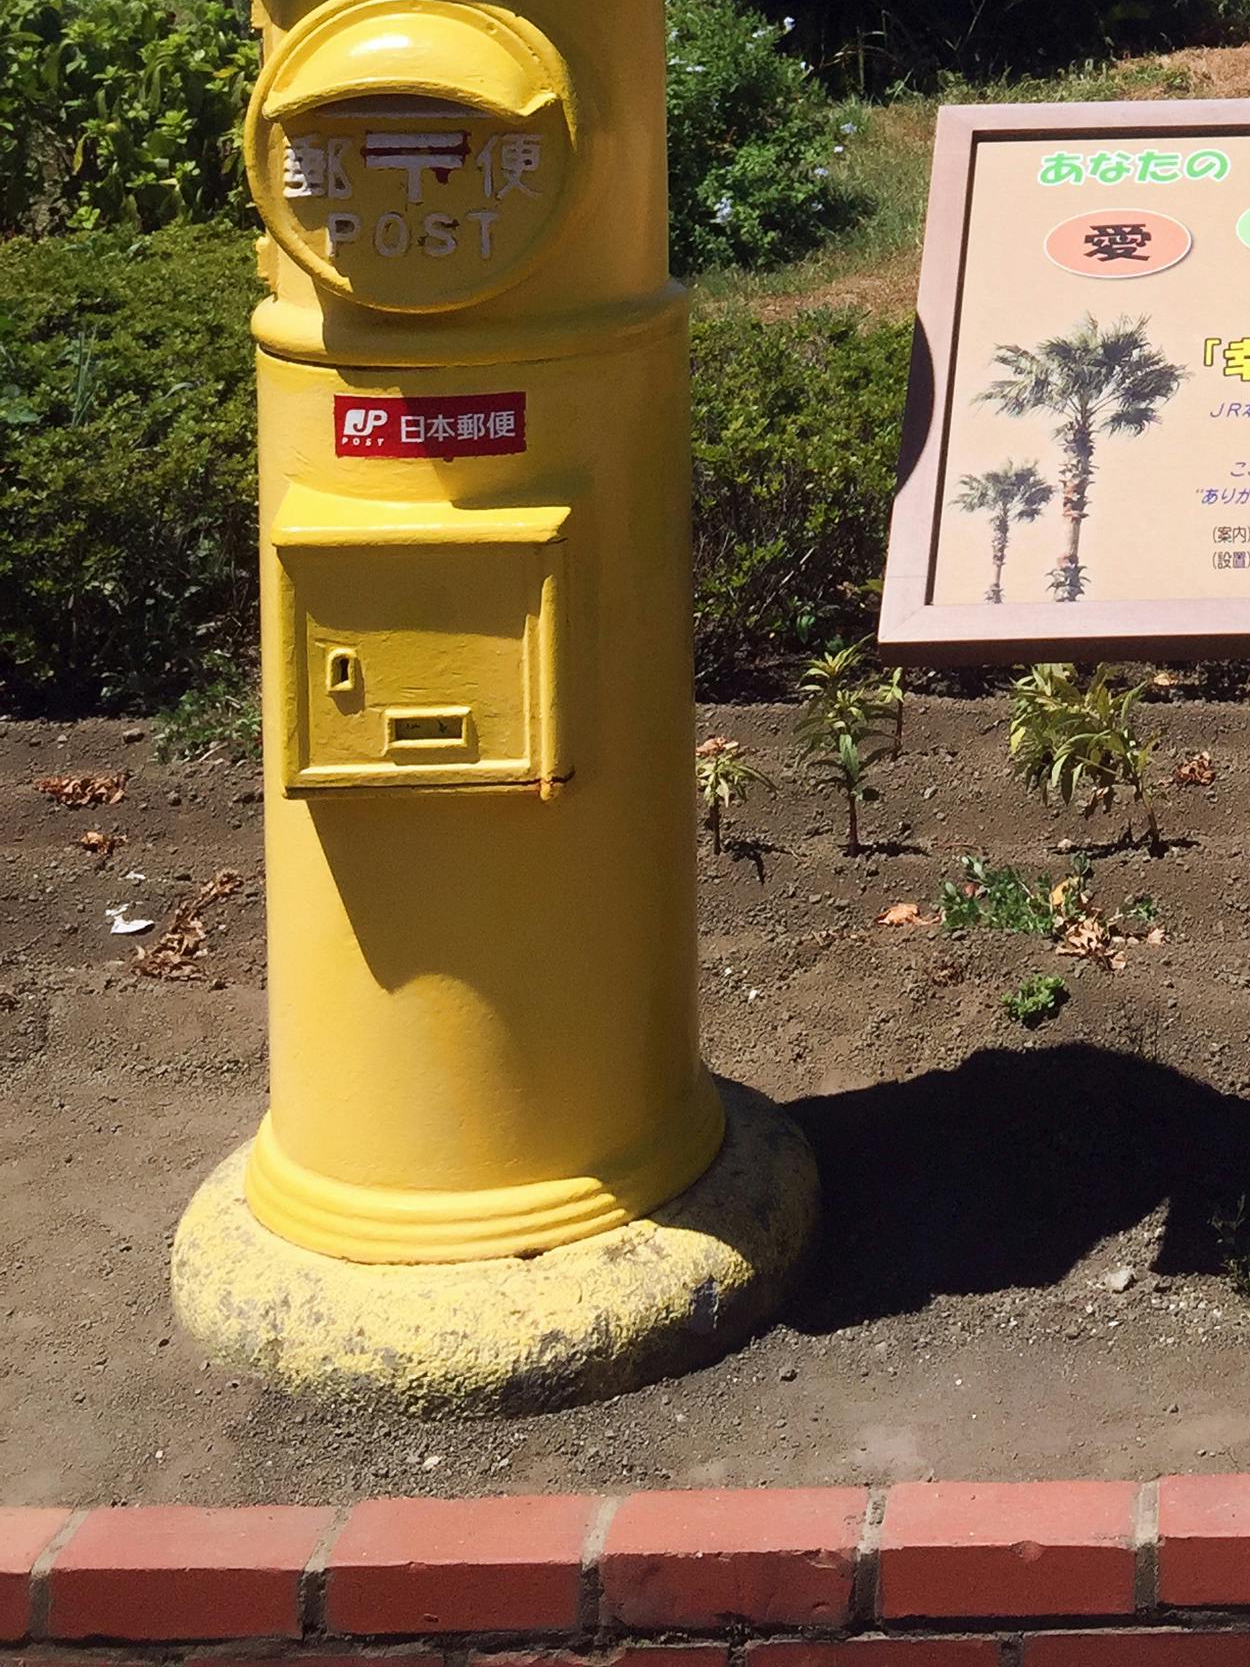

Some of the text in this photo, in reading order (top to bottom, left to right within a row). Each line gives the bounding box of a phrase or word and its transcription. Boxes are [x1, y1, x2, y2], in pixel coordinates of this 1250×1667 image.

[1039, 150, 1230, 184] あなたの
[326, 211, 499, 260] POST
[1083, 223, 1152, 262] 愛
[341, 437, 386, 447] POST
[344, 409, 516, 444] JP 日本郵便
